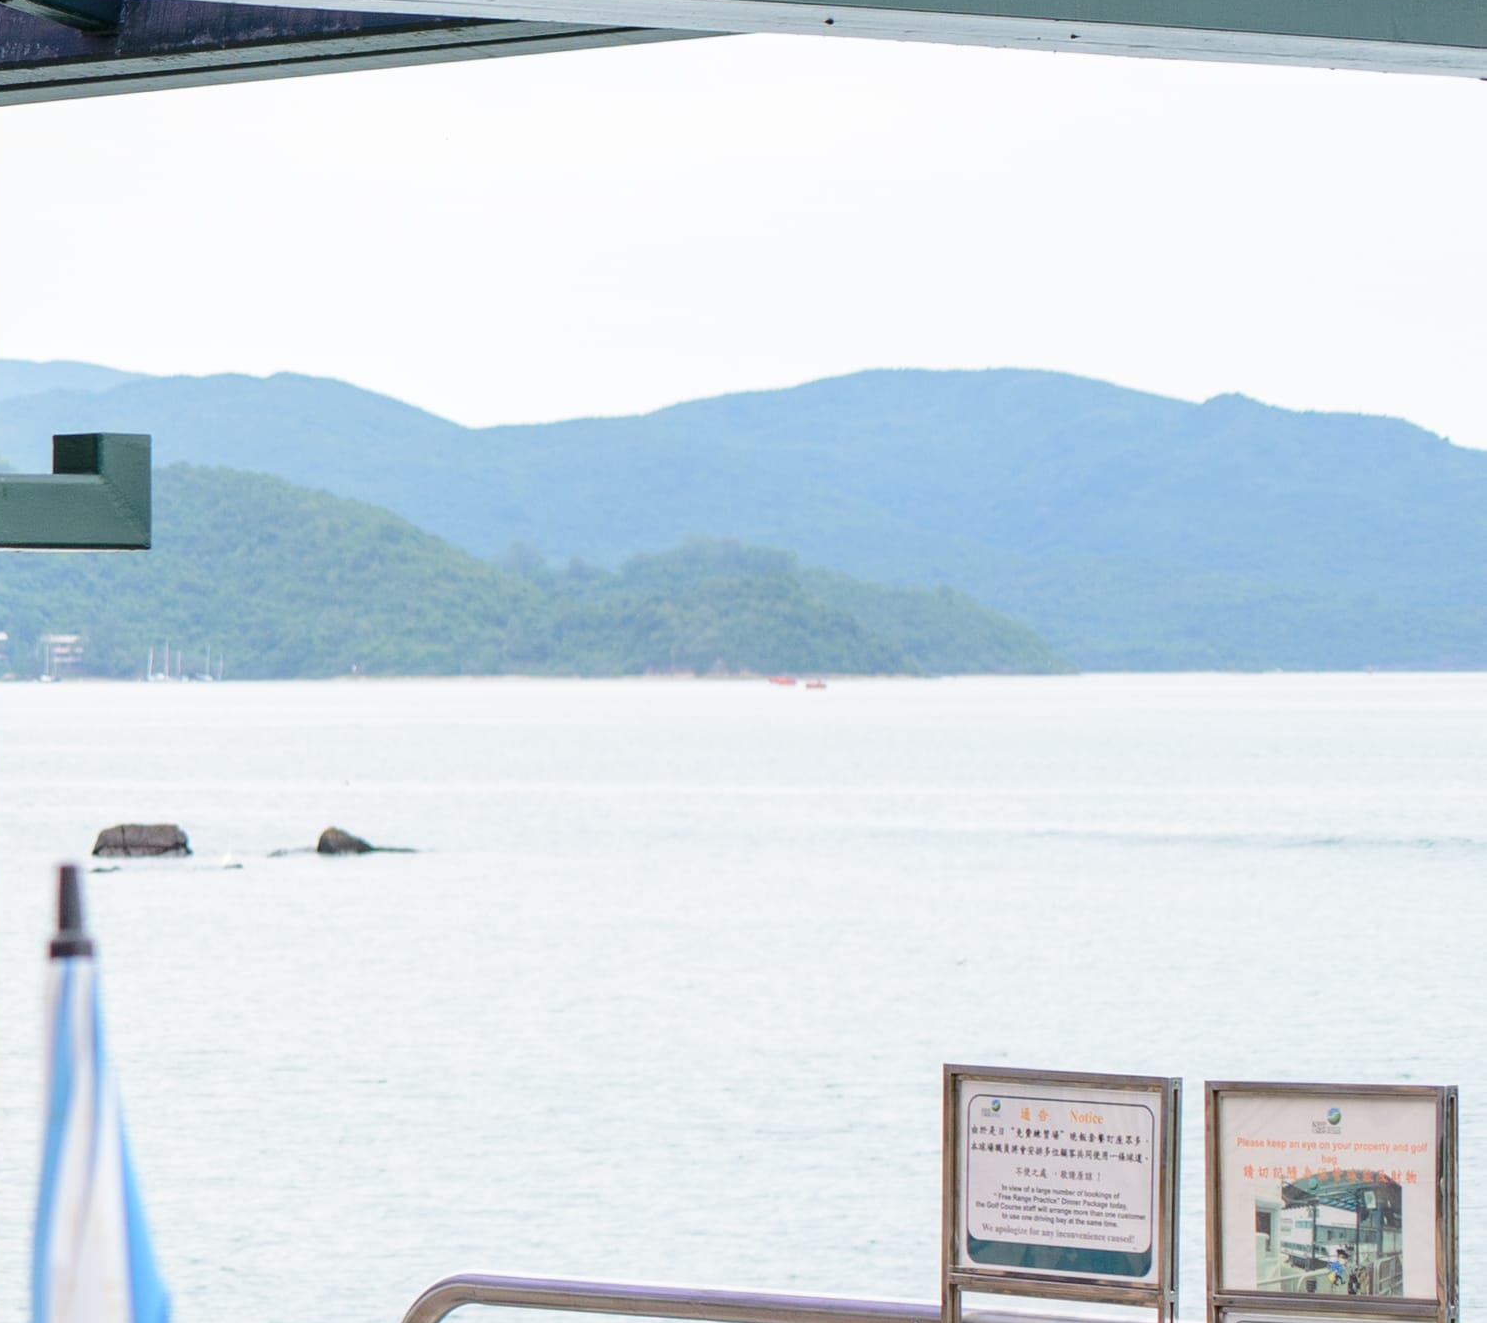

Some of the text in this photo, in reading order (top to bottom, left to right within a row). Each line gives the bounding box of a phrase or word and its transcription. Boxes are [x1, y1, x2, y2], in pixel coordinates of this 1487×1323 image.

[1069, 1109, 1104, 1125] Notice
[1236, 1137, 1428, 1154] Please keep an eye on your property and golf
[1321, 1154, 1337, 1165] bag
[1009, 1185, 1022, 1193] view
[1036, 1186, 1051, 1195] large
[1077, 1189, 1083, 1197] of
[1084, 1190, 1112, 1199] bookings
[1013, 1194, 1032, 1204] Range
[1061, 1197, 1081, 1205] Dinner
[1083, 1199, 1108, 1208] Package
[987, 1201, 999, 1209] Golf
[1000, 1203, 1021, 1211] Course
[1049, 1208, 1072, 1216] arrange
[1034, 1214, 1054, 1224] driving
[1056, 1217, 1066, 1225] bay
[982, 1223, 993, 1231] We
[995, 1224, 1028, 1235] apologize
[1030, 1226, 1040, 1235] for
[1042, 1228, 1054, 1238] any
[1056, 1229, 1106, 1242] inconvenience
